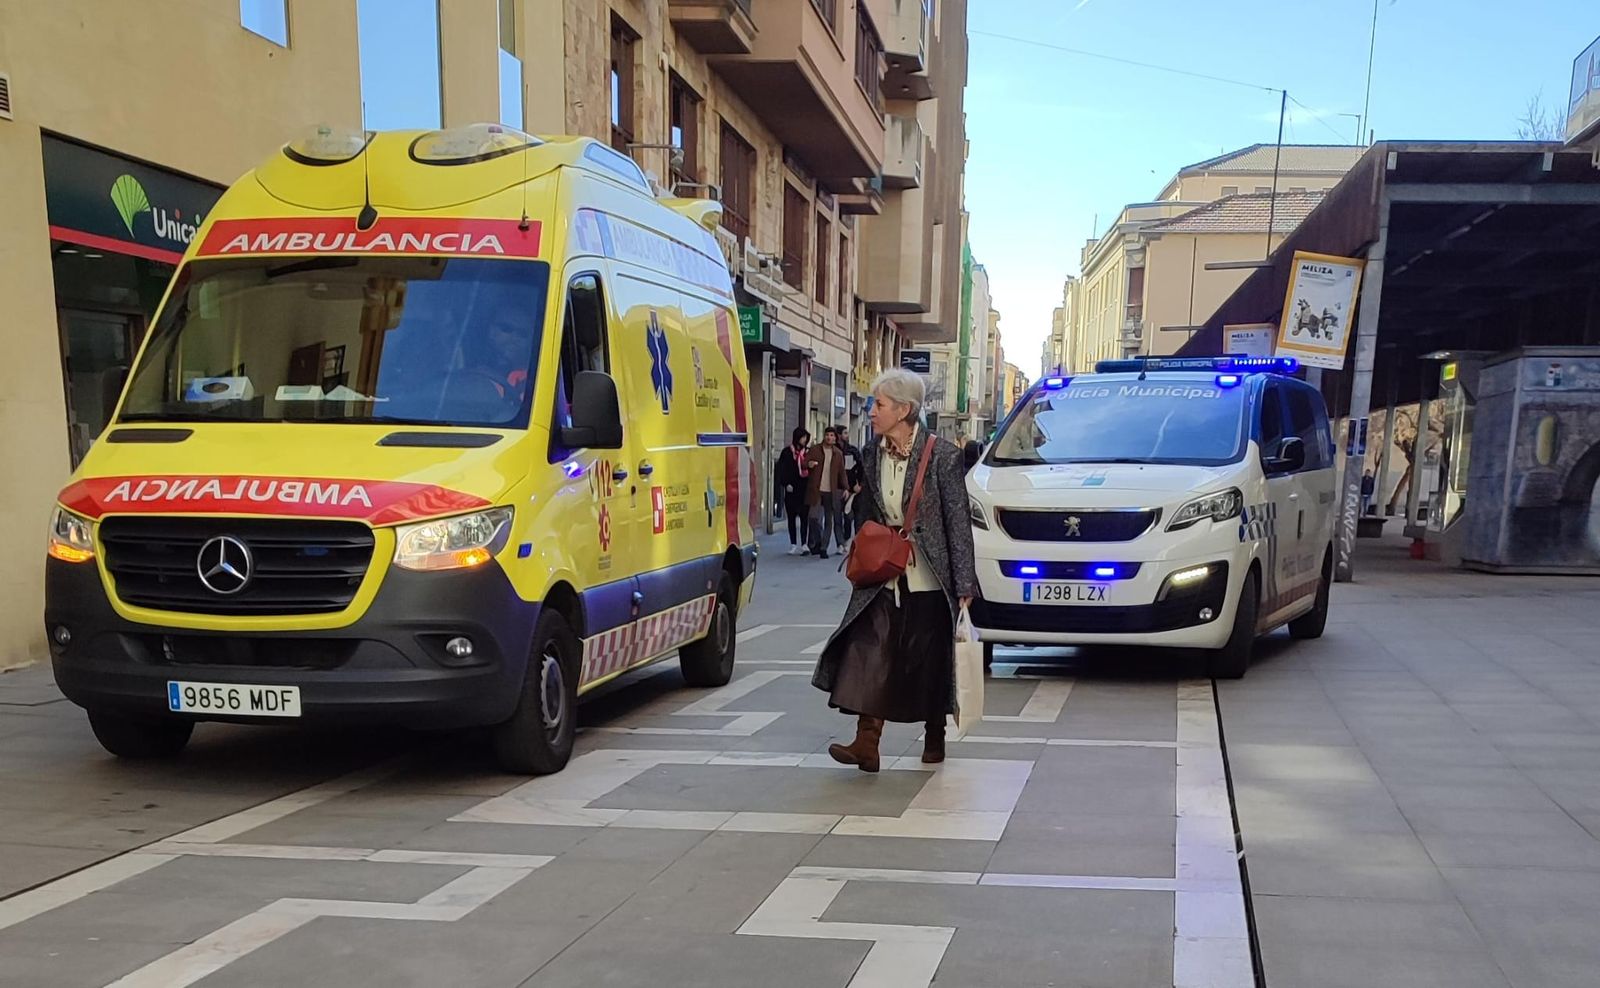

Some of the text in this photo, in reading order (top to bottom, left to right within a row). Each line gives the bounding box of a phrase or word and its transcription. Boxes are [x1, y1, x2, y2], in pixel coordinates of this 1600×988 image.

[153, 207, 200, 244] Unica
[220, 233, 504, 253] AMBULANCIA
[1302, 264, 1333, 275] MELIZA
[1118, 385, 1222, 400] Municipal
[595, 459, 613, 499] 112
[1037, 585, 1106, 601] 1298 LZX
[184, 687, 293, 711] 9856 MDF
